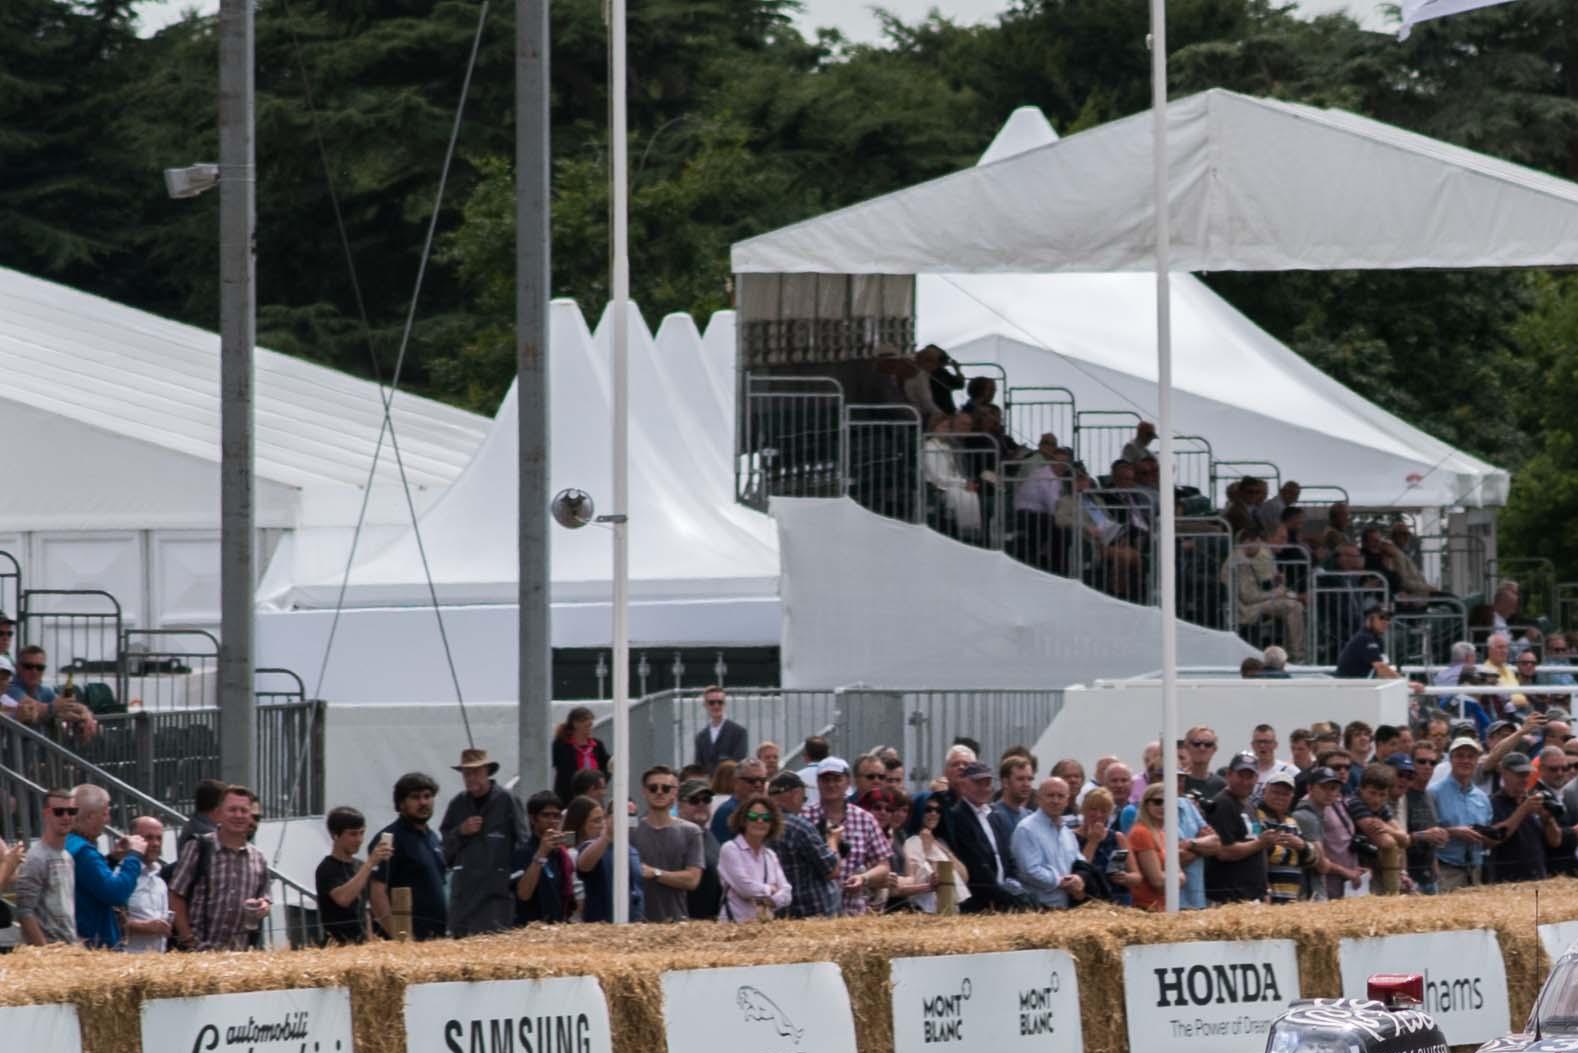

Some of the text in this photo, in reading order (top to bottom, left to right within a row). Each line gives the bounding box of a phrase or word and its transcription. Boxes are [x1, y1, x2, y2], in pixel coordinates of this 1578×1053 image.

[1153, 962, 1283, 1007] HONDA
[922, 993, 963, 1018] MONT
[1018, 987, 1051, 1011] MONT
[226, 1010, 309, 1046] automobili
[923, 1019, 963, 1043] BLANC
[1019, 1011, 1055, 1036] BLANC
[1169, 1019, 1193, 1038] The
[1194, 1018, 1230, 1037] Power
[1231, 1016, 1244, 1035] of
